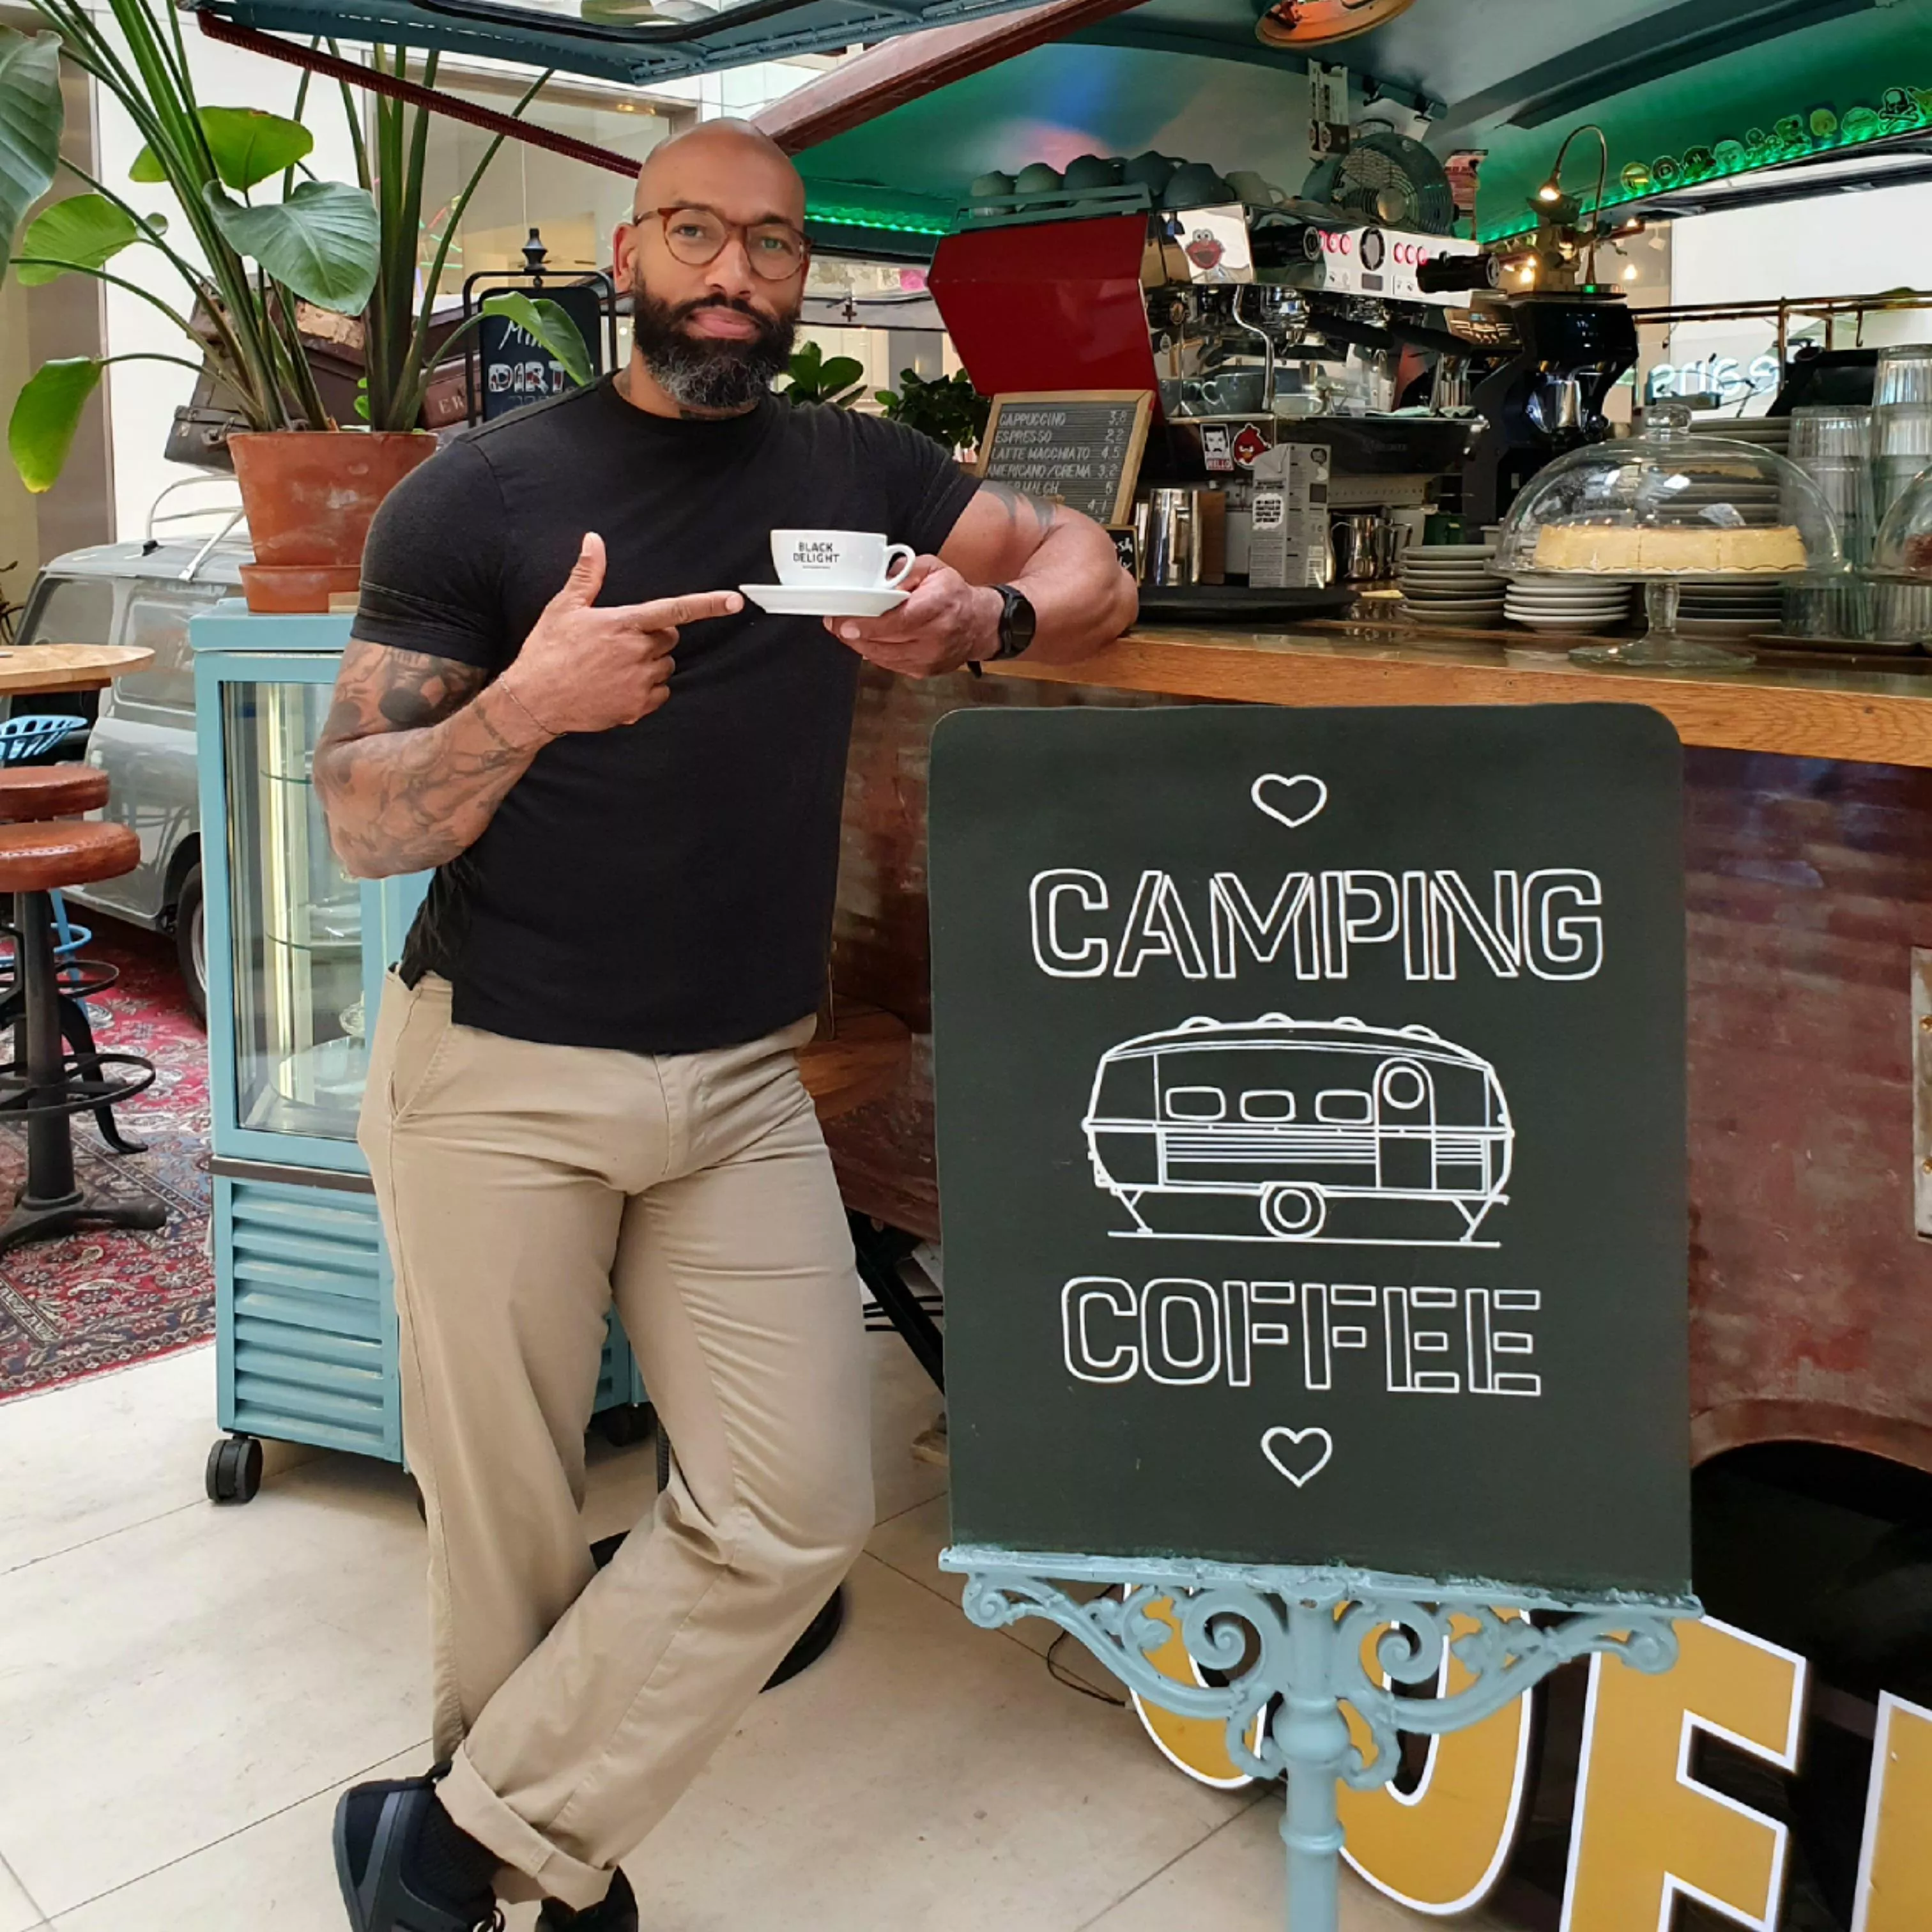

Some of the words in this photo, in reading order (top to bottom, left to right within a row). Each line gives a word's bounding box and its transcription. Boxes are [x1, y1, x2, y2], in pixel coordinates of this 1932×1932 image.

[488, 361, 594, 394] DIRT
[999, 412, 1067, 427] CAPPUCCINO
[994, 429, 1053, 445] ESPRESSO
[991, 447, 1025, 460] LATTE
[1027, 446, 1091, 461] MACCHIATO
[798, 542, 833, 553] BLACK
[792, 552, 841, 564] DELIGHT
[1029, 868, 1603, 980] CAMPING
[1061, 1276, 1542, 1396] COFFEE
